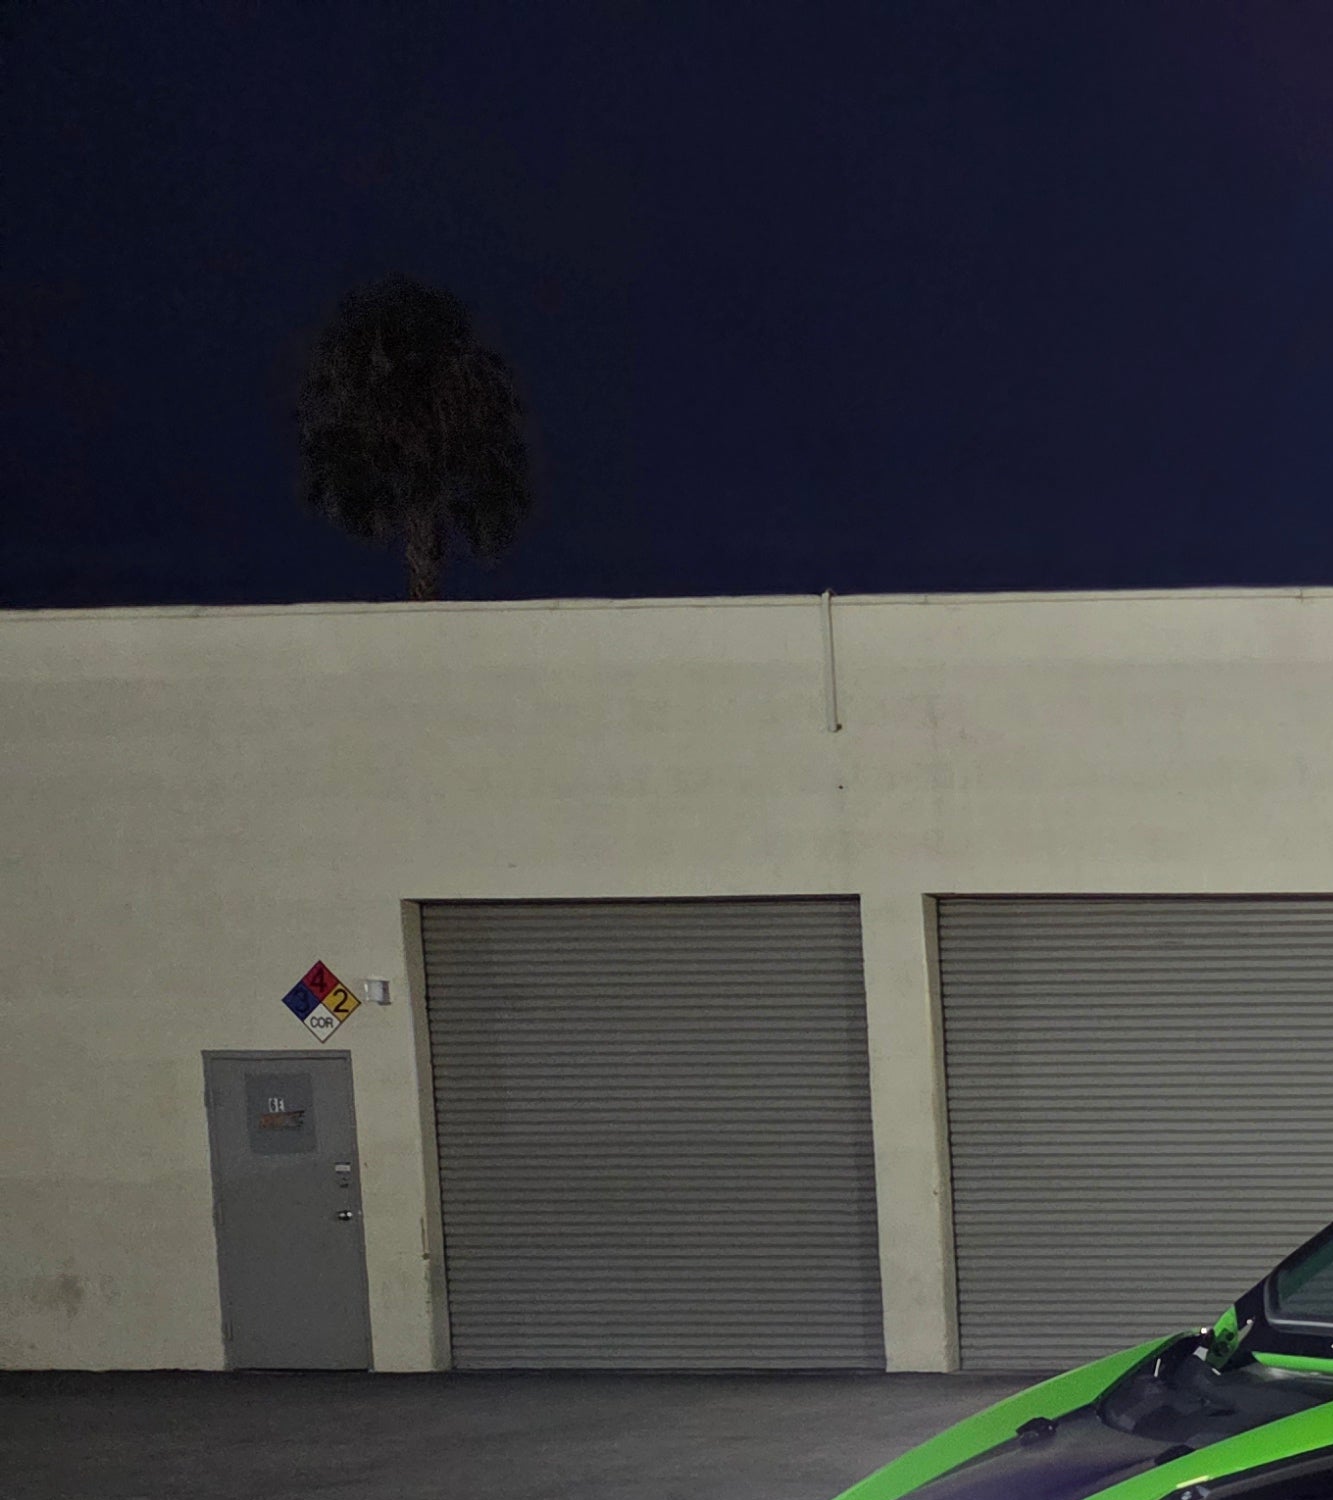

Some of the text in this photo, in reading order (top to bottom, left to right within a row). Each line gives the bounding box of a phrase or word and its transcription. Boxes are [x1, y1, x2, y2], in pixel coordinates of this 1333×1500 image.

[310, 968, 327, 993] 4
[294, 987, 310, 1013] 3
[333, 988, 349, 1013] 2
[310, 1016, 334, 1028] COR
